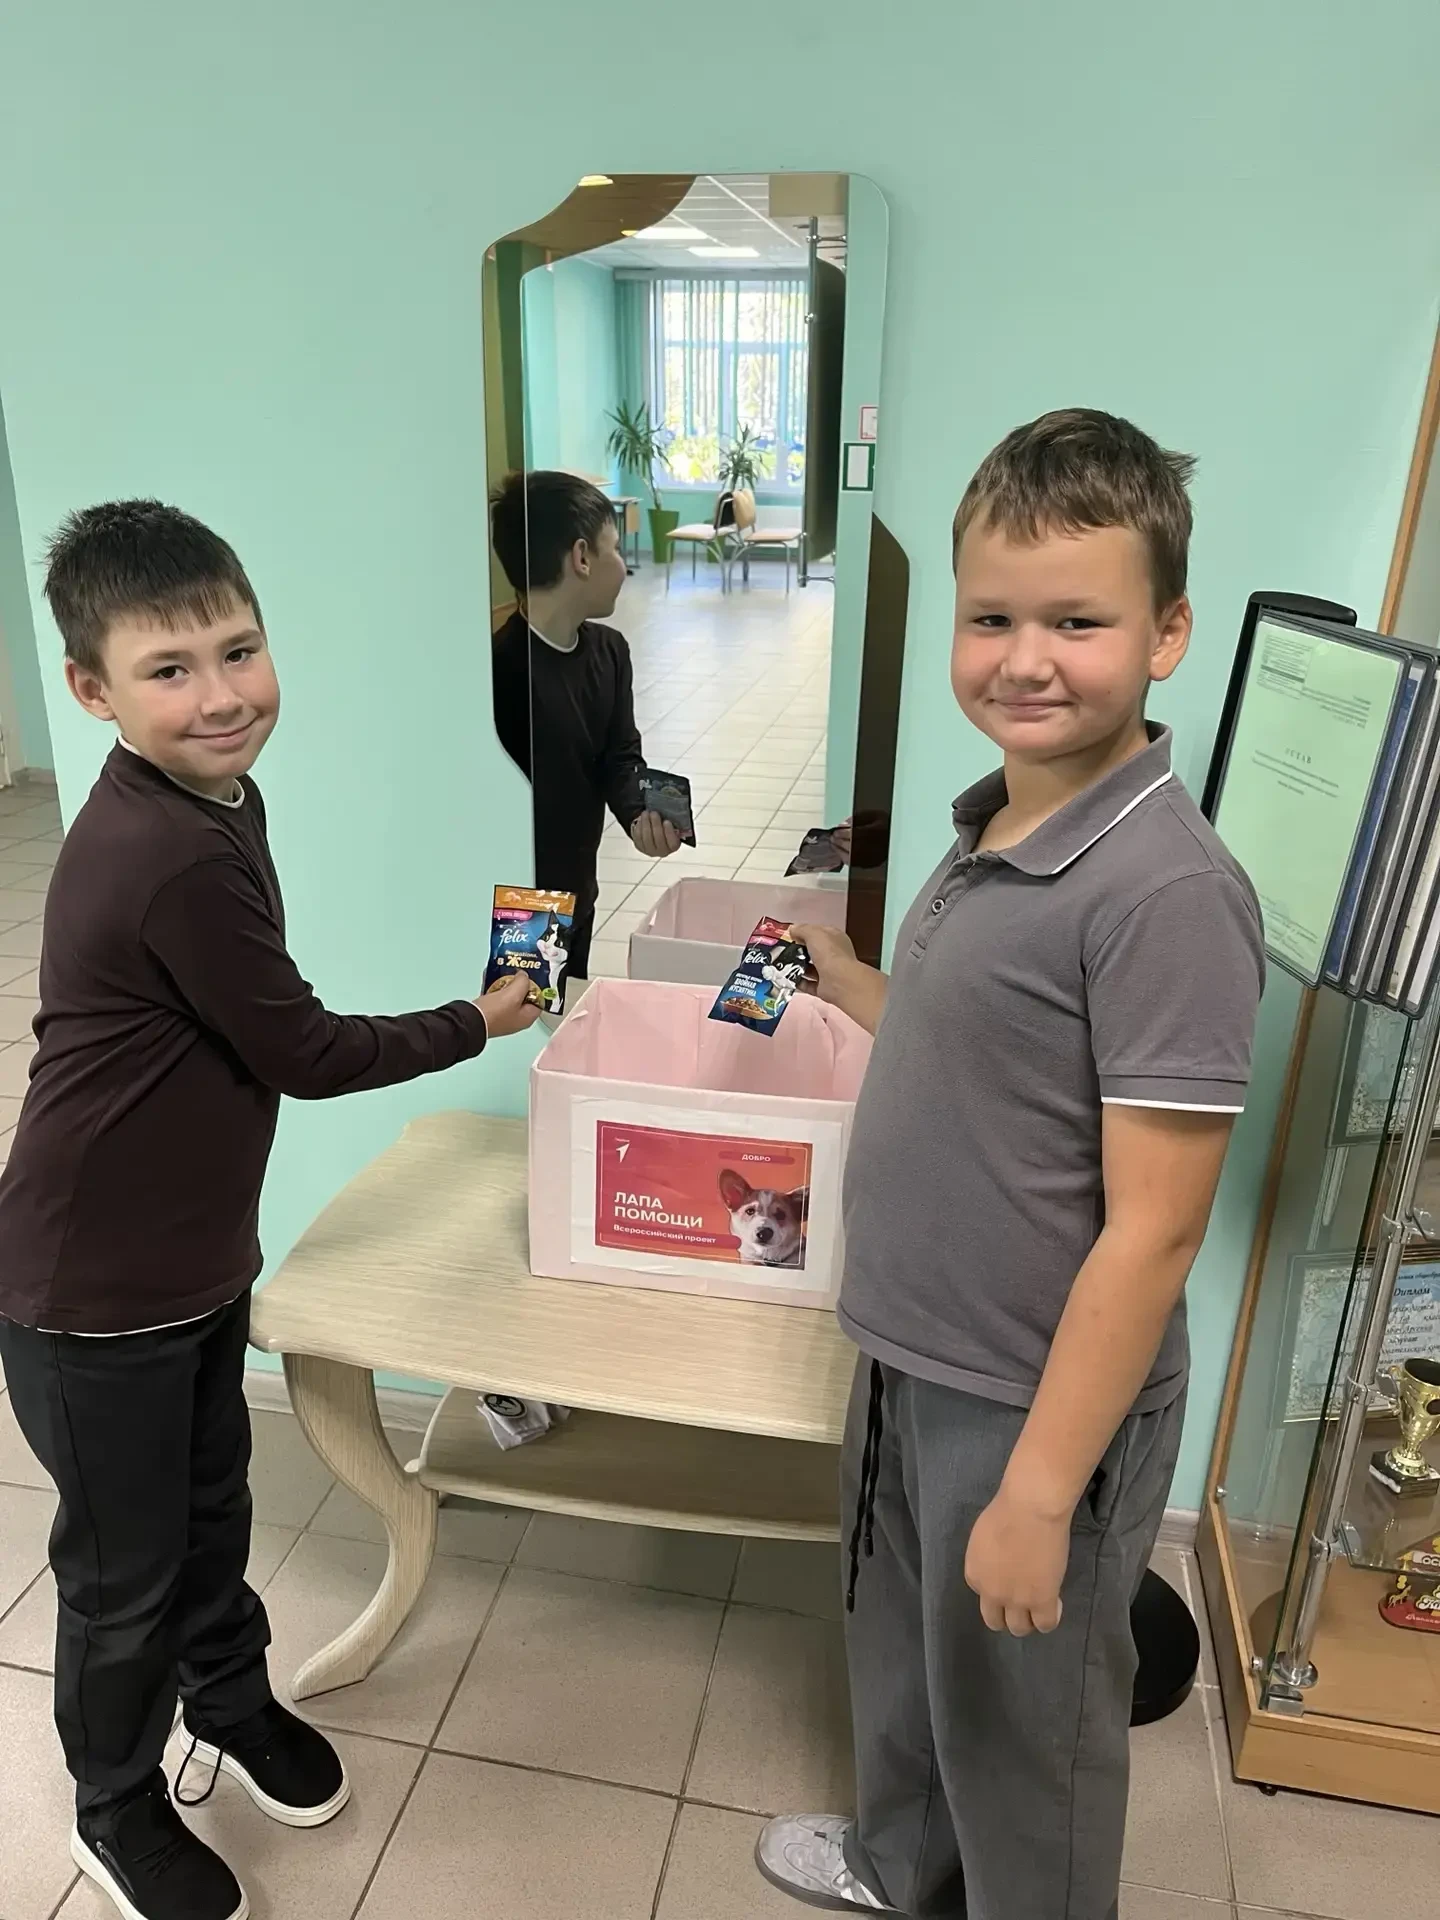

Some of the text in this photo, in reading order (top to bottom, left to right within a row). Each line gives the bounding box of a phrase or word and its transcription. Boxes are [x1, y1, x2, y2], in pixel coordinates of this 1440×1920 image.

[498, 928, 529, 948] felix
[506, 956, 542, 969] Желе
[741, 1153, 771, 1162] ДОБРО
[614, 1191, 663, 1209] ЛАПА
[614, 1206, 703, 1229] ПОМОЩИ
[613, 1224, 717, 1245] Всероссийский проект
[1393, 1287, 1431, 1297] Диплом
